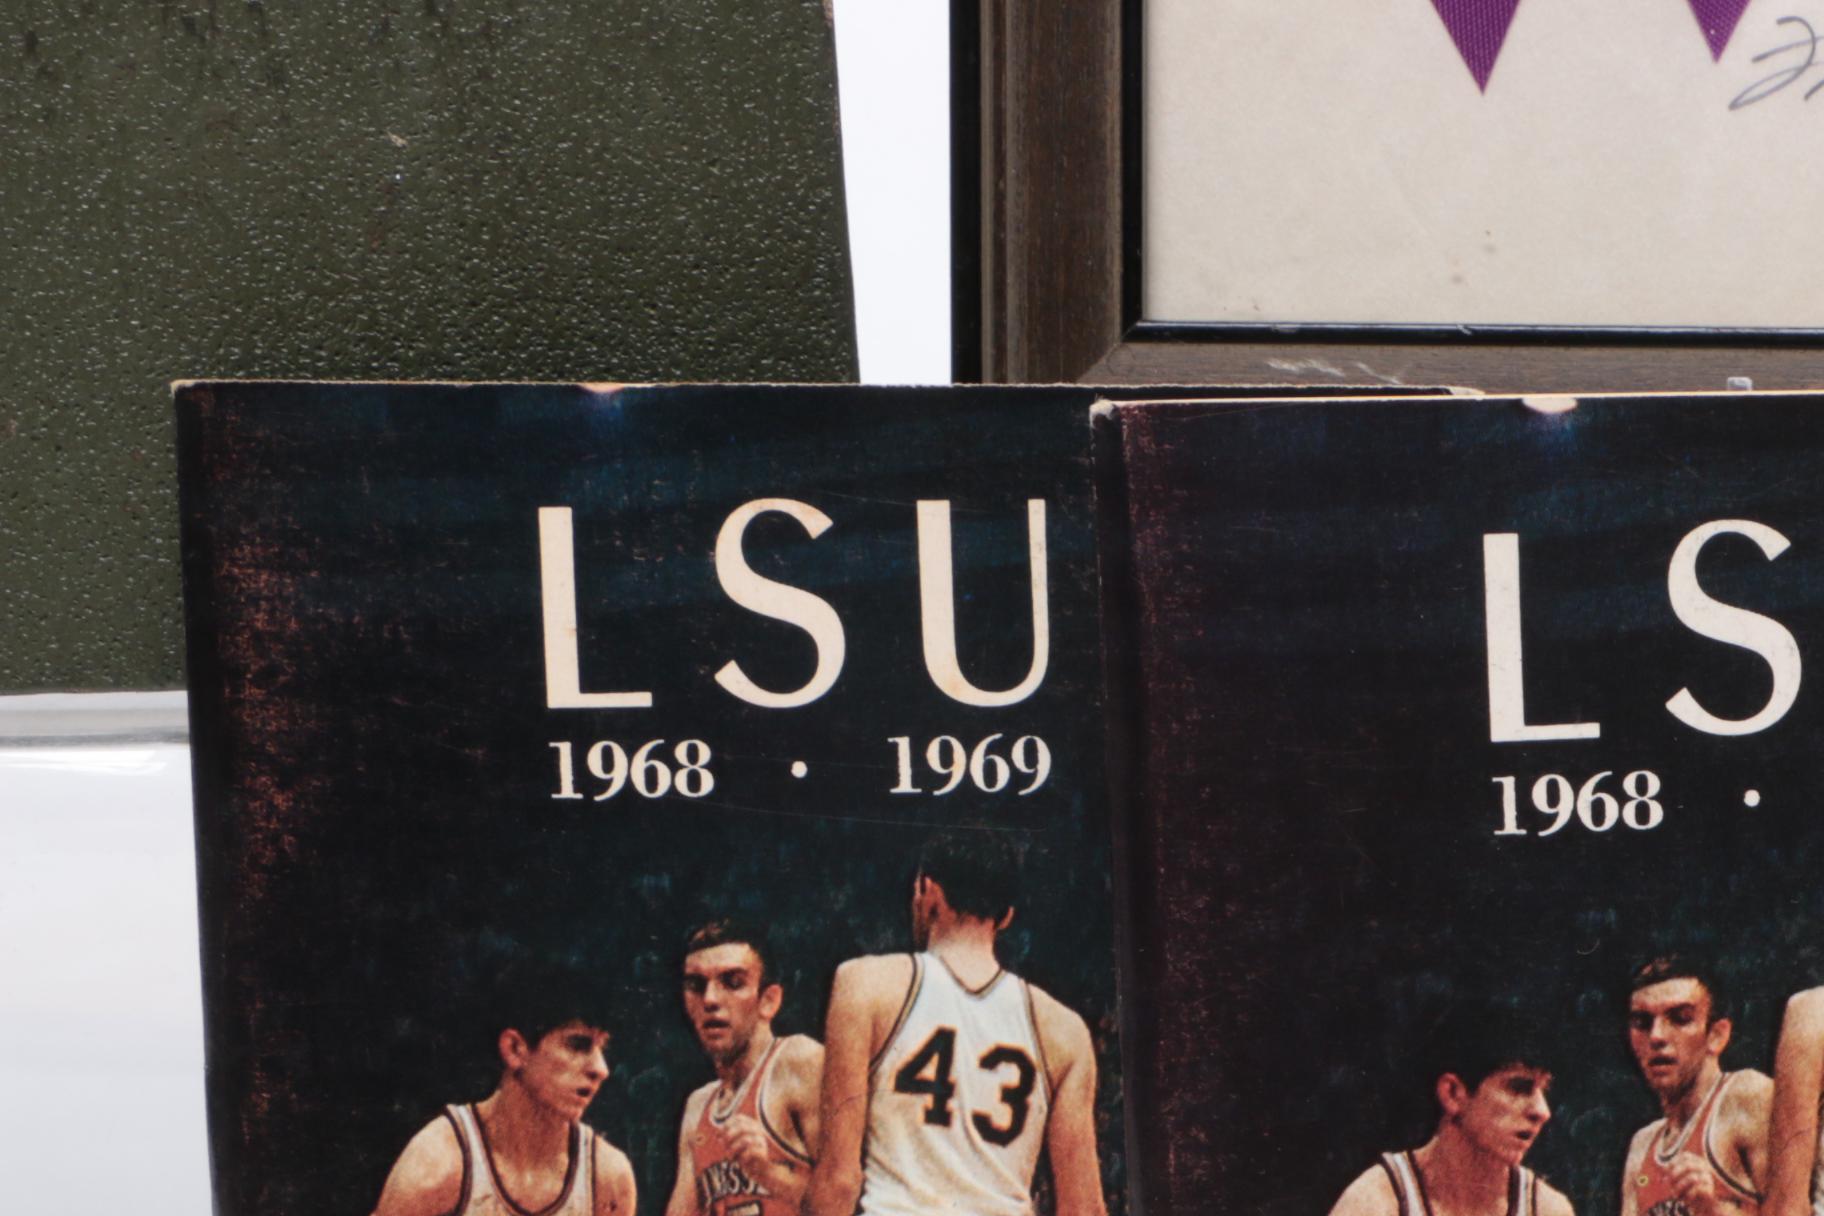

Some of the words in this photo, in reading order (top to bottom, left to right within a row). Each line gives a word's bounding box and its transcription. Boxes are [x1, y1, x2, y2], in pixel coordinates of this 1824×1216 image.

[538, 497, 1050, 709] LSU
[548, 738, 715, 801] 1968
[886, 732, 1052, 797] 1969
[1491, 769, 1664, 836] 1968
[894, 1026, 1037, 1148] 43
